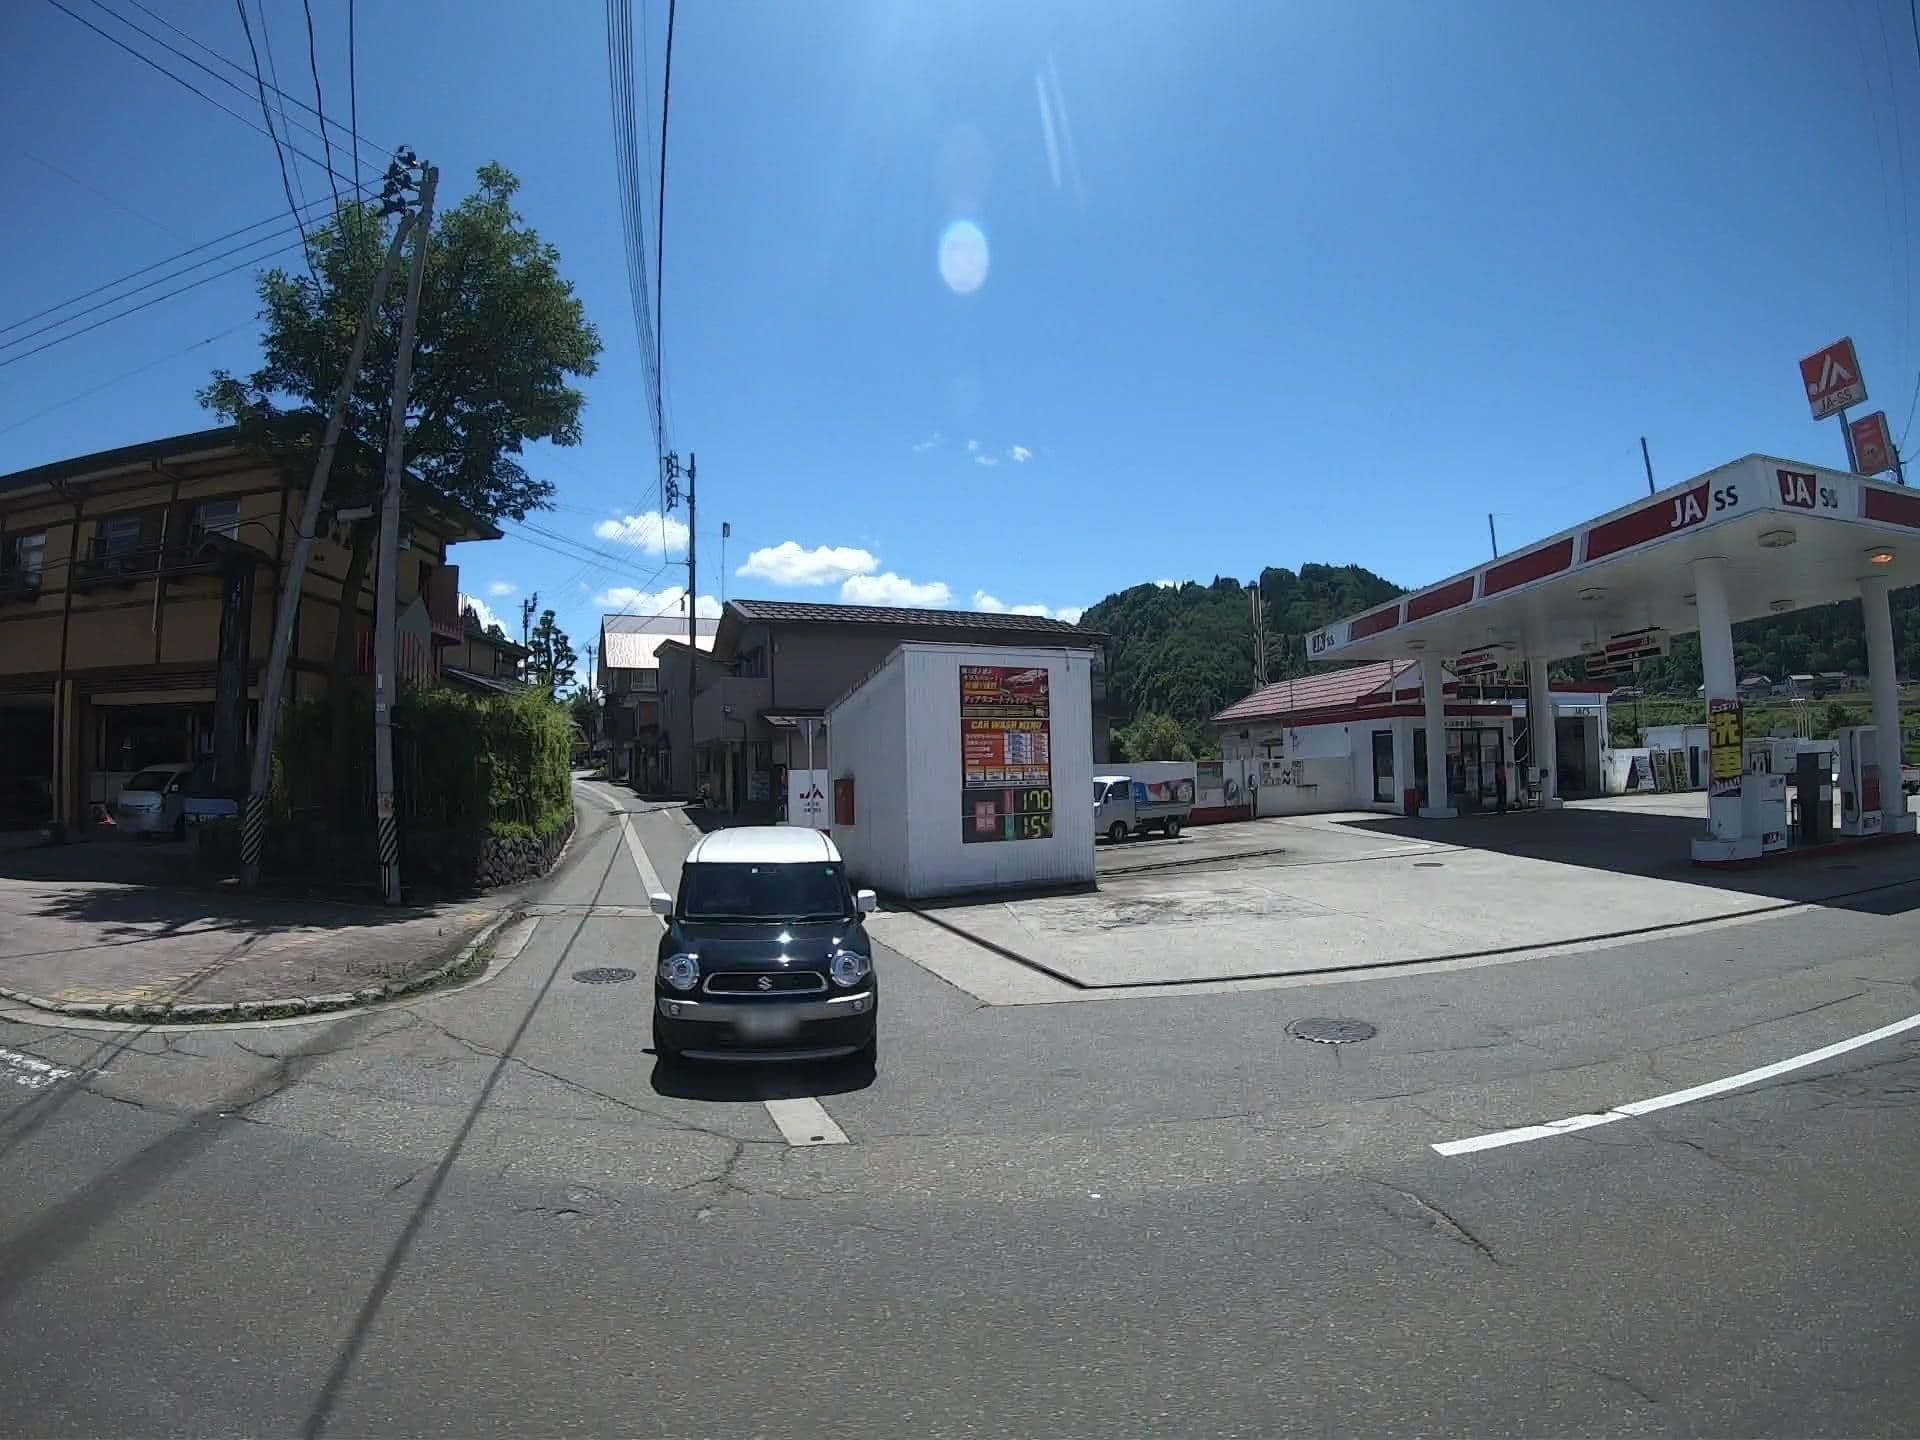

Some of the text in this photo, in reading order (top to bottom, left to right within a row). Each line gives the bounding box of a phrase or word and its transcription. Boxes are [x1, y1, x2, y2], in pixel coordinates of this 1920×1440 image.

[1784, 475, 1839, 508] JA SS
[1670, 485, 1738, 528] JA SS
[971, 720, 989, 729] CAR
[991, 720, 1017, 729] WASH
[1023, 789, 1052, 810] 170
